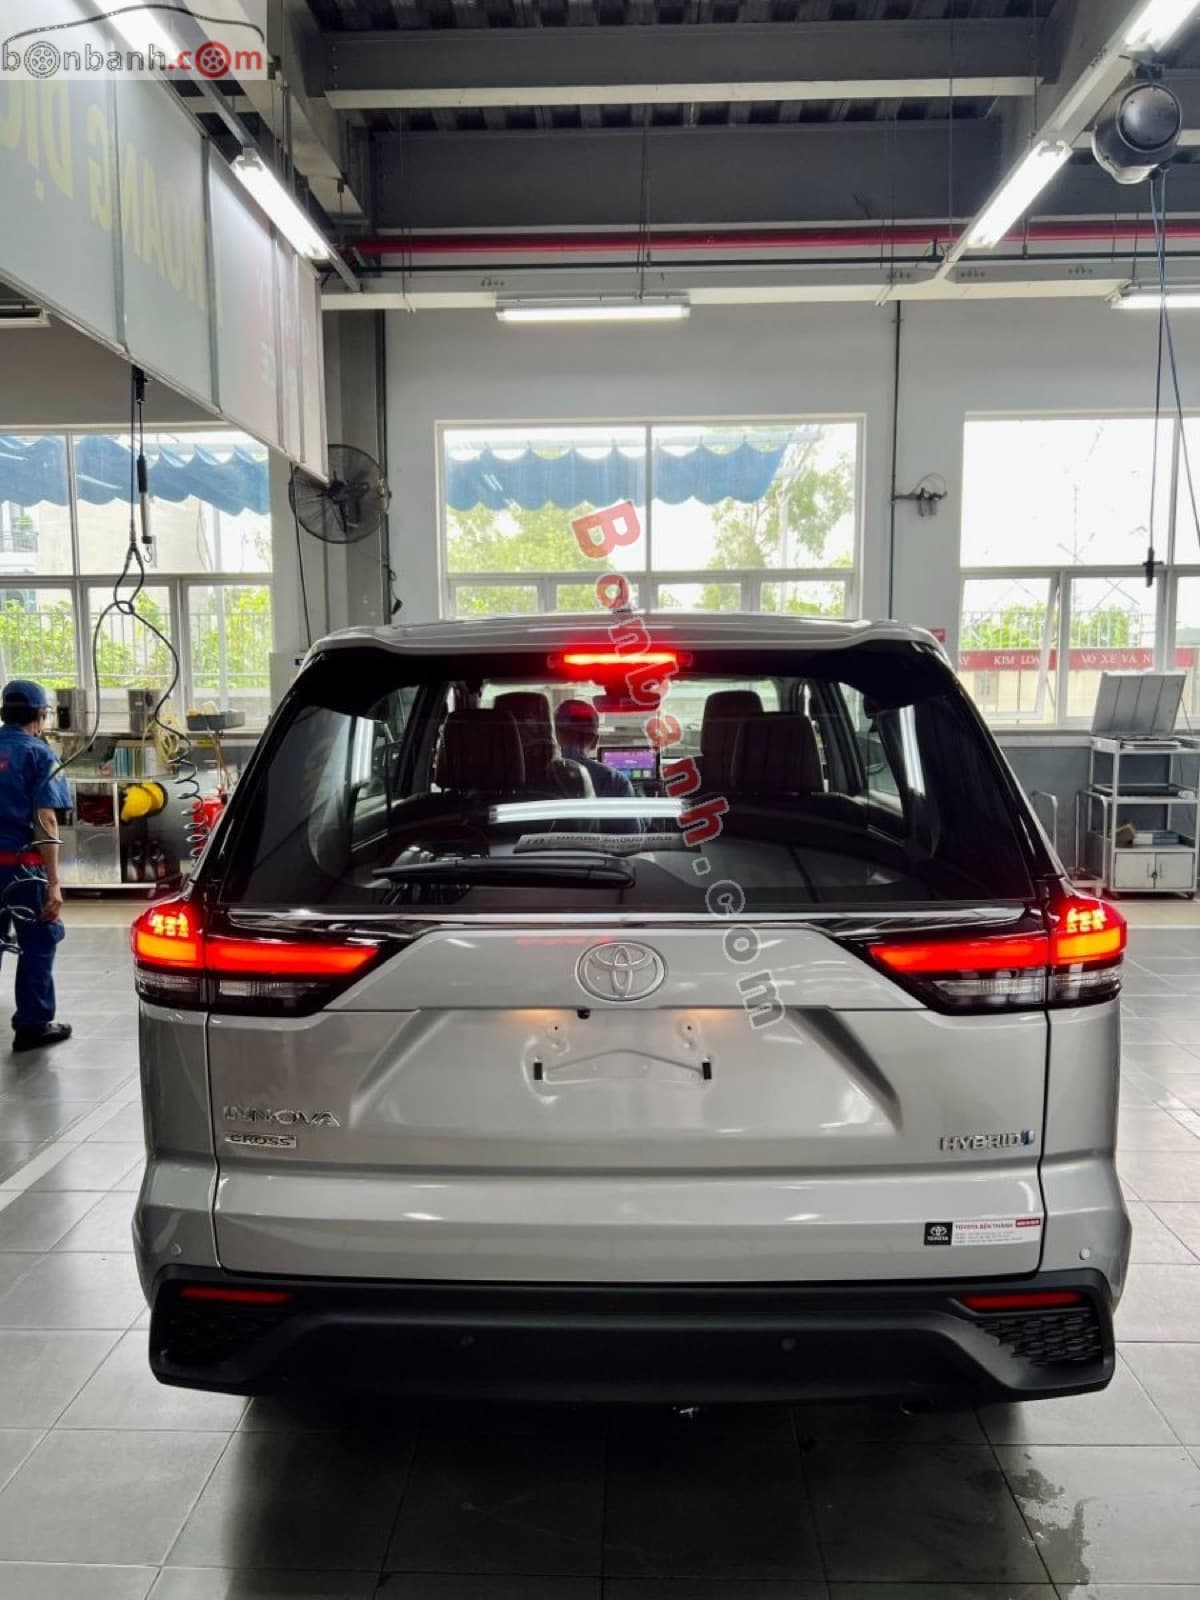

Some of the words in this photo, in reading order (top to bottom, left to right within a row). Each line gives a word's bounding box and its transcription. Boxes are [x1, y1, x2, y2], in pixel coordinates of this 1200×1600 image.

[223, 1105, 341, 1128] INNOVA
[228, 1133, 296, 1147] CROSS
[939, 1133, 1020, 1151] HYBRID
